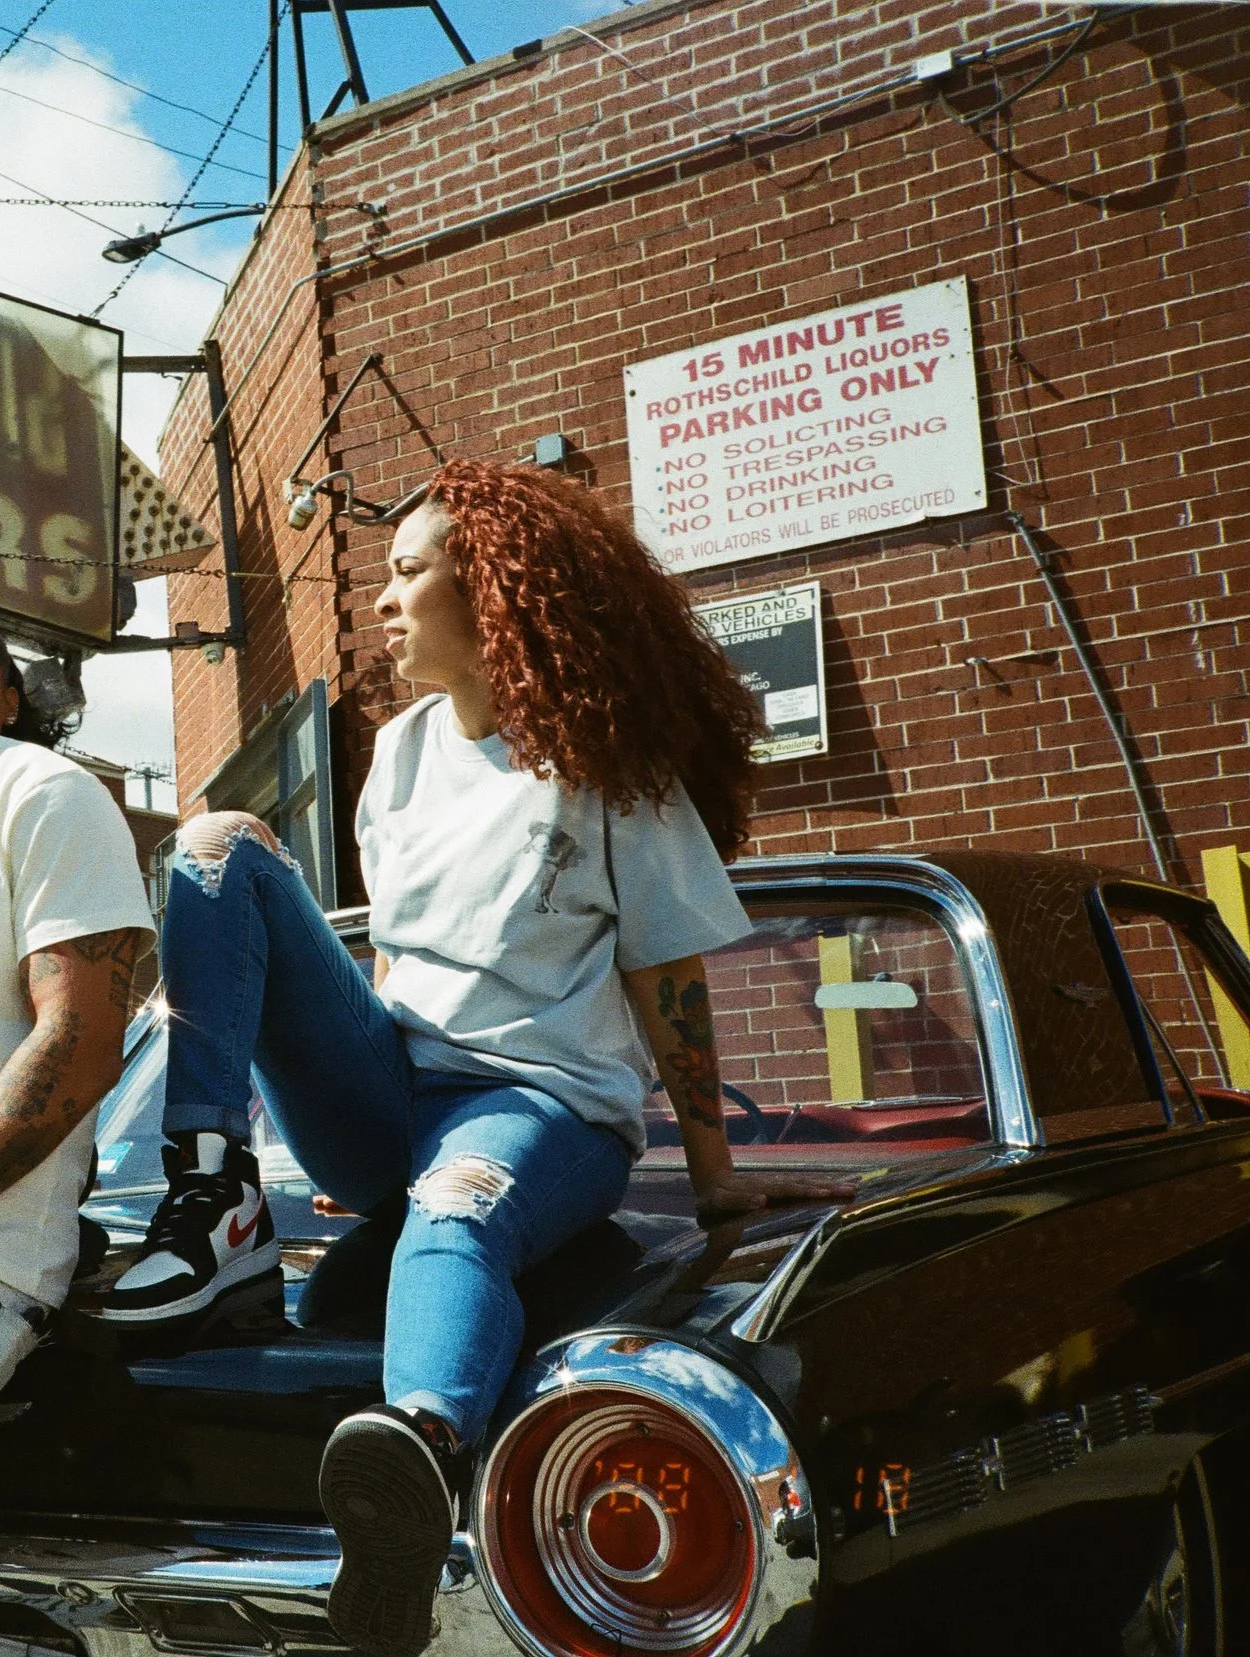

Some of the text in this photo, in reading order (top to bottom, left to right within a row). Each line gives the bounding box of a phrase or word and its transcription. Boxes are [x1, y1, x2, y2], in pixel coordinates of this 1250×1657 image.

[646, 328, 951, 421] ROTHSCHILD LIQUORS
[682, 303, 906, 383] 15 MINUTE
[659, 356, 941, 448] PARKING ONLY
[664, 407, 892, 474] NO SOLICTING
[665, 416, 948, 495] NO TRESPASSING
[667, 455, 877, 516] NO DRINKING
[668, 473, 895, 537] NO LOITERING
[690, 528, 771, 559] VIOLATORS
[778, 519, 814, 540] WILL
[820, 513, 840, 530] BE
[848, 489, 956, 523] PROSECUTED
[722, 607, 806, 633] VEHICLES
[731, 630, 770, 644] EXPENSE
[771, 627, 783, 637] BY
[762, 597, 797, 614] AND
[776, 737, 815, 752] Available
